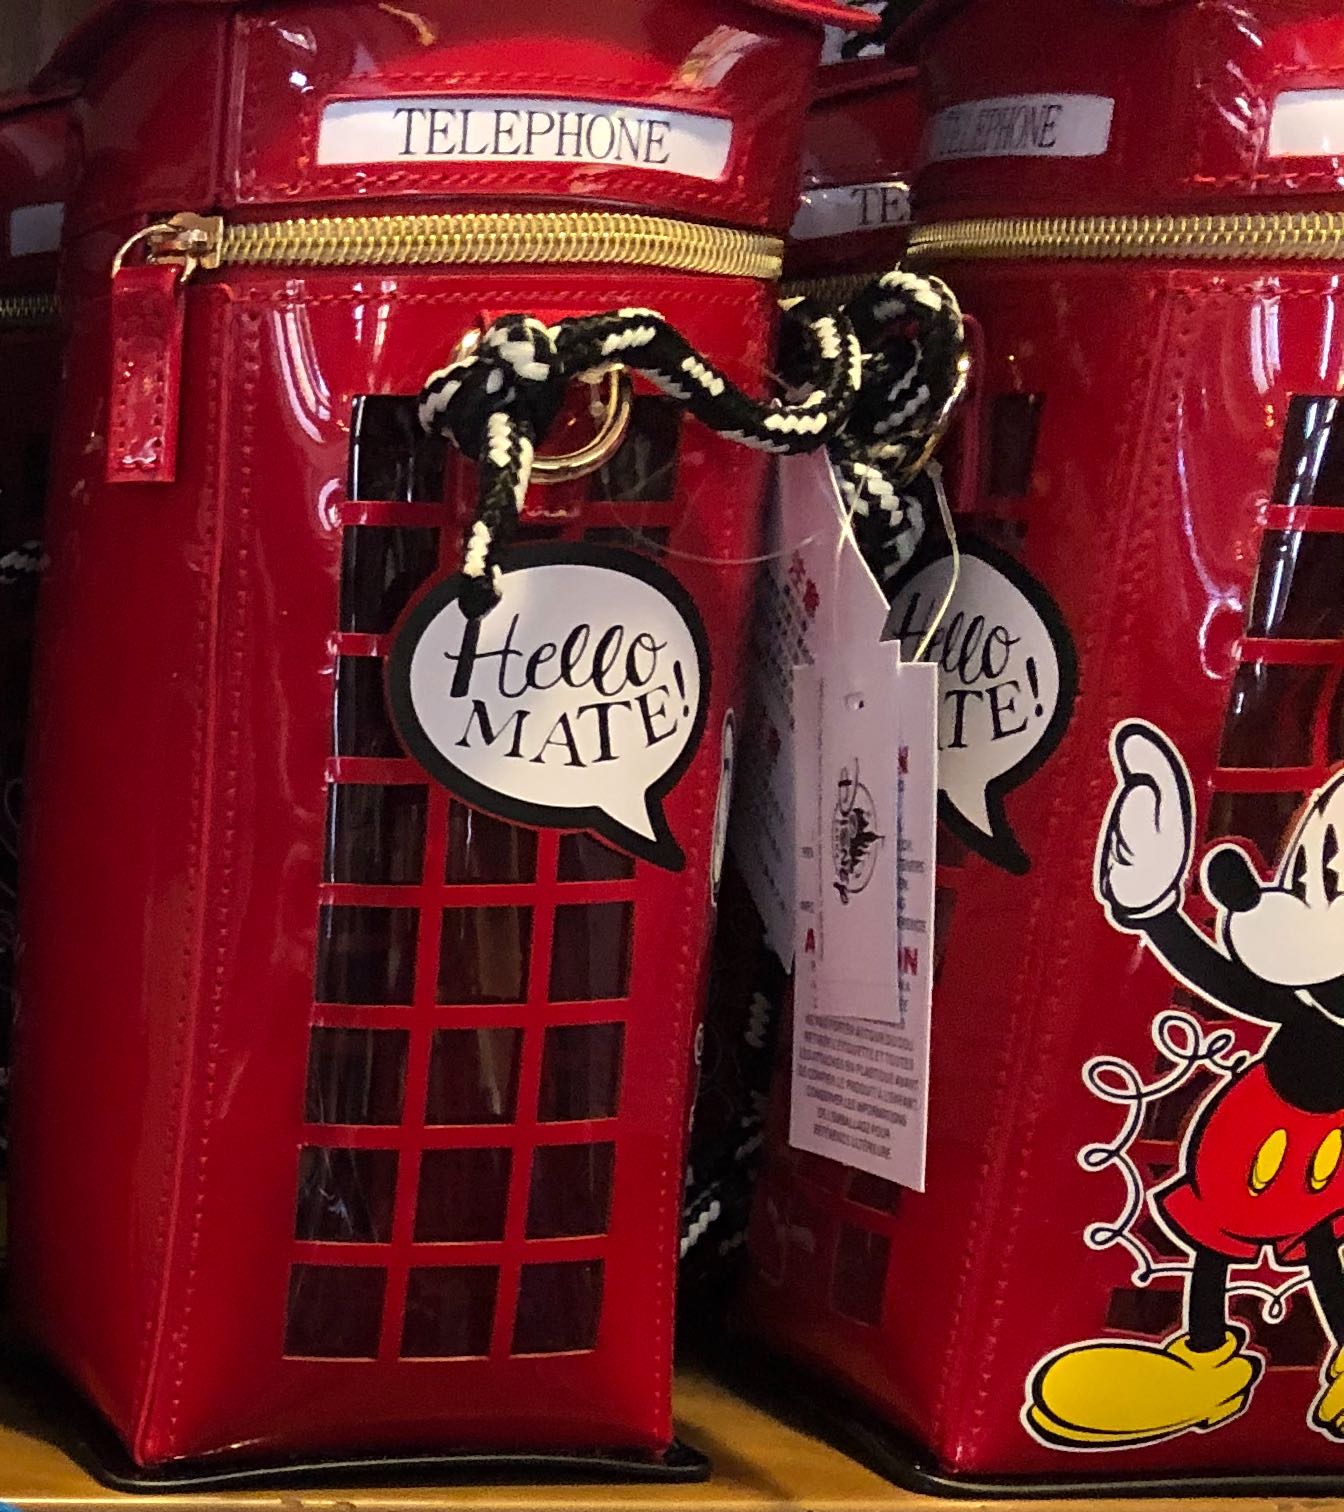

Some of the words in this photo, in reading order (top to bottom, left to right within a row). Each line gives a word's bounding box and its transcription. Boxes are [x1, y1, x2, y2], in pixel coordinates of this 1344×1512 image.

[393, 107, 672, 164] TELEPHONE
[443, 613, 667, 699] Hello
[454, 659, 691, 768] MATE!
[939, 656, 1044, 752] TE!
